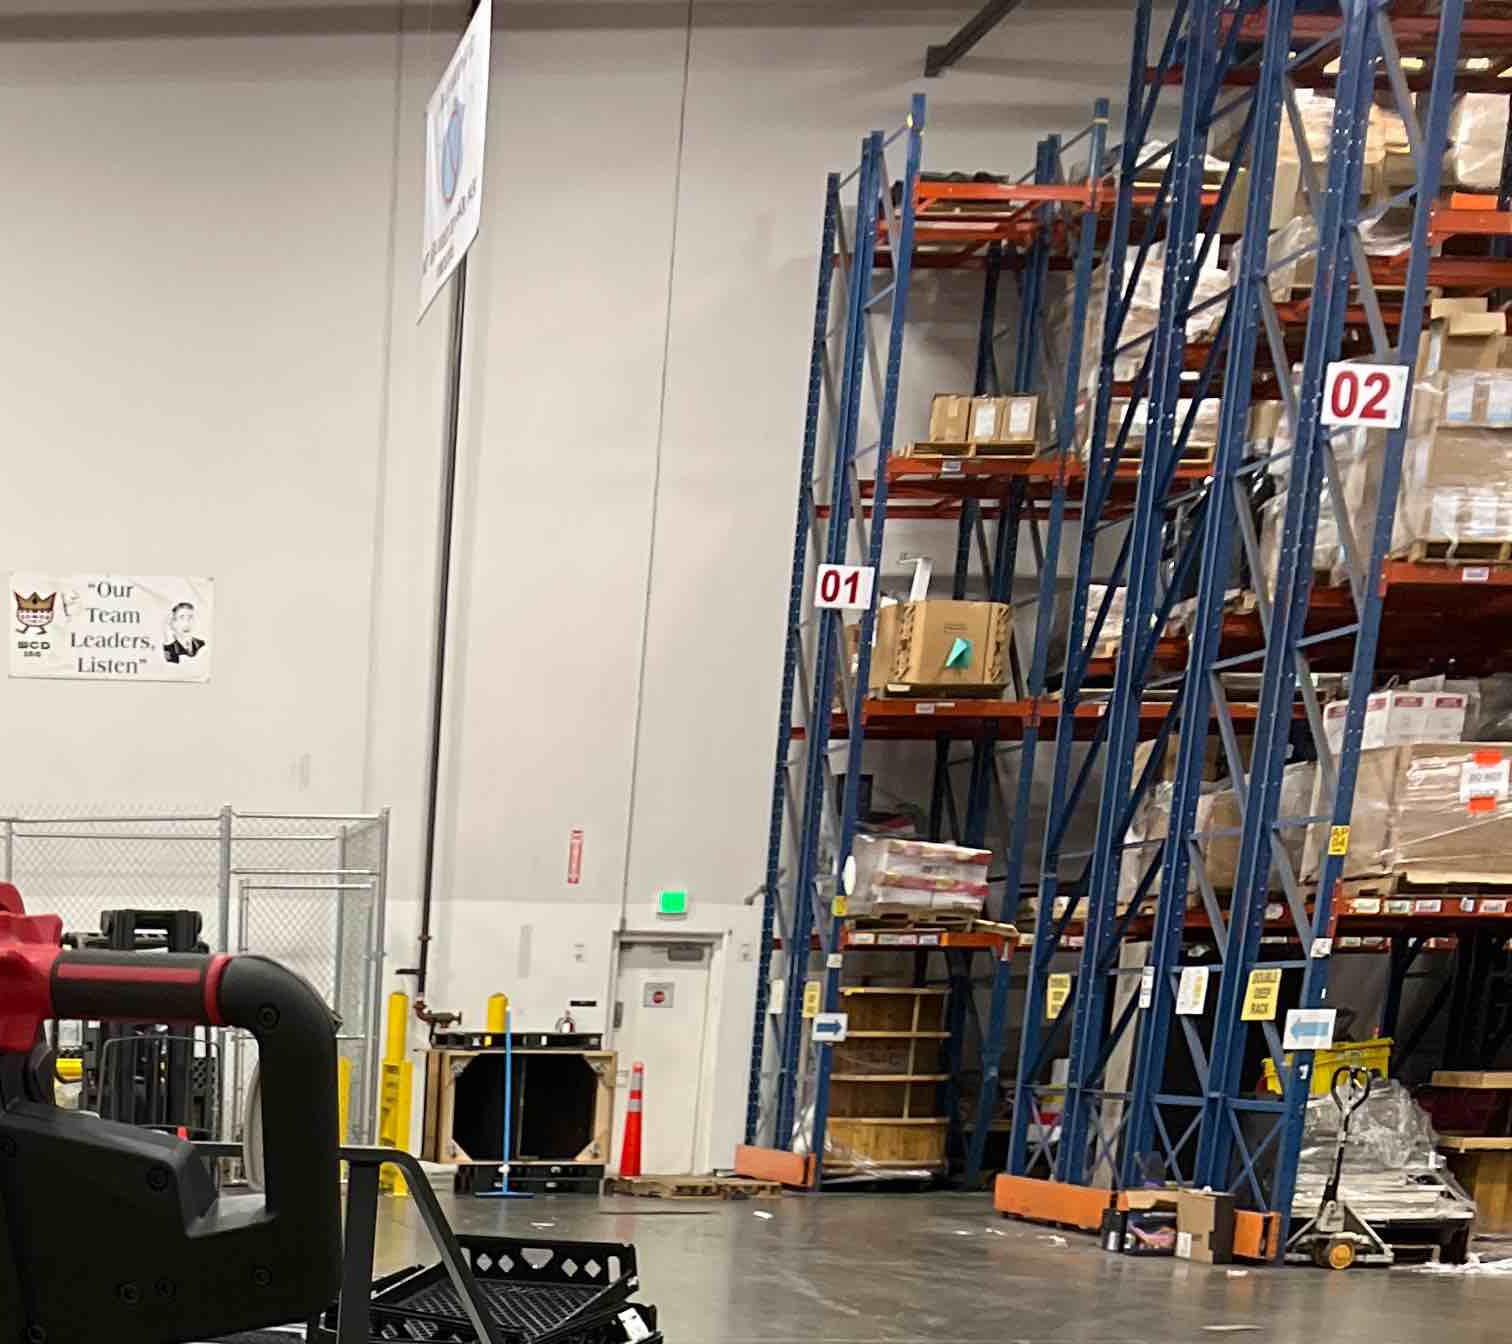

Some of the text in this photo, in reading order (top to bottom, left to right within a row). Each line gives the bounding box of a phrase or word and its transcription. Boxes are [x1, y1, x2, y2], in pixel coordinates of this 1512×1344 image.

[1331, 370, 1391, 420] 02
[821, 569, 860, 604] 01
[85, 607, 141, 625] Team
[70, 632, 157, 652] Leaders,
